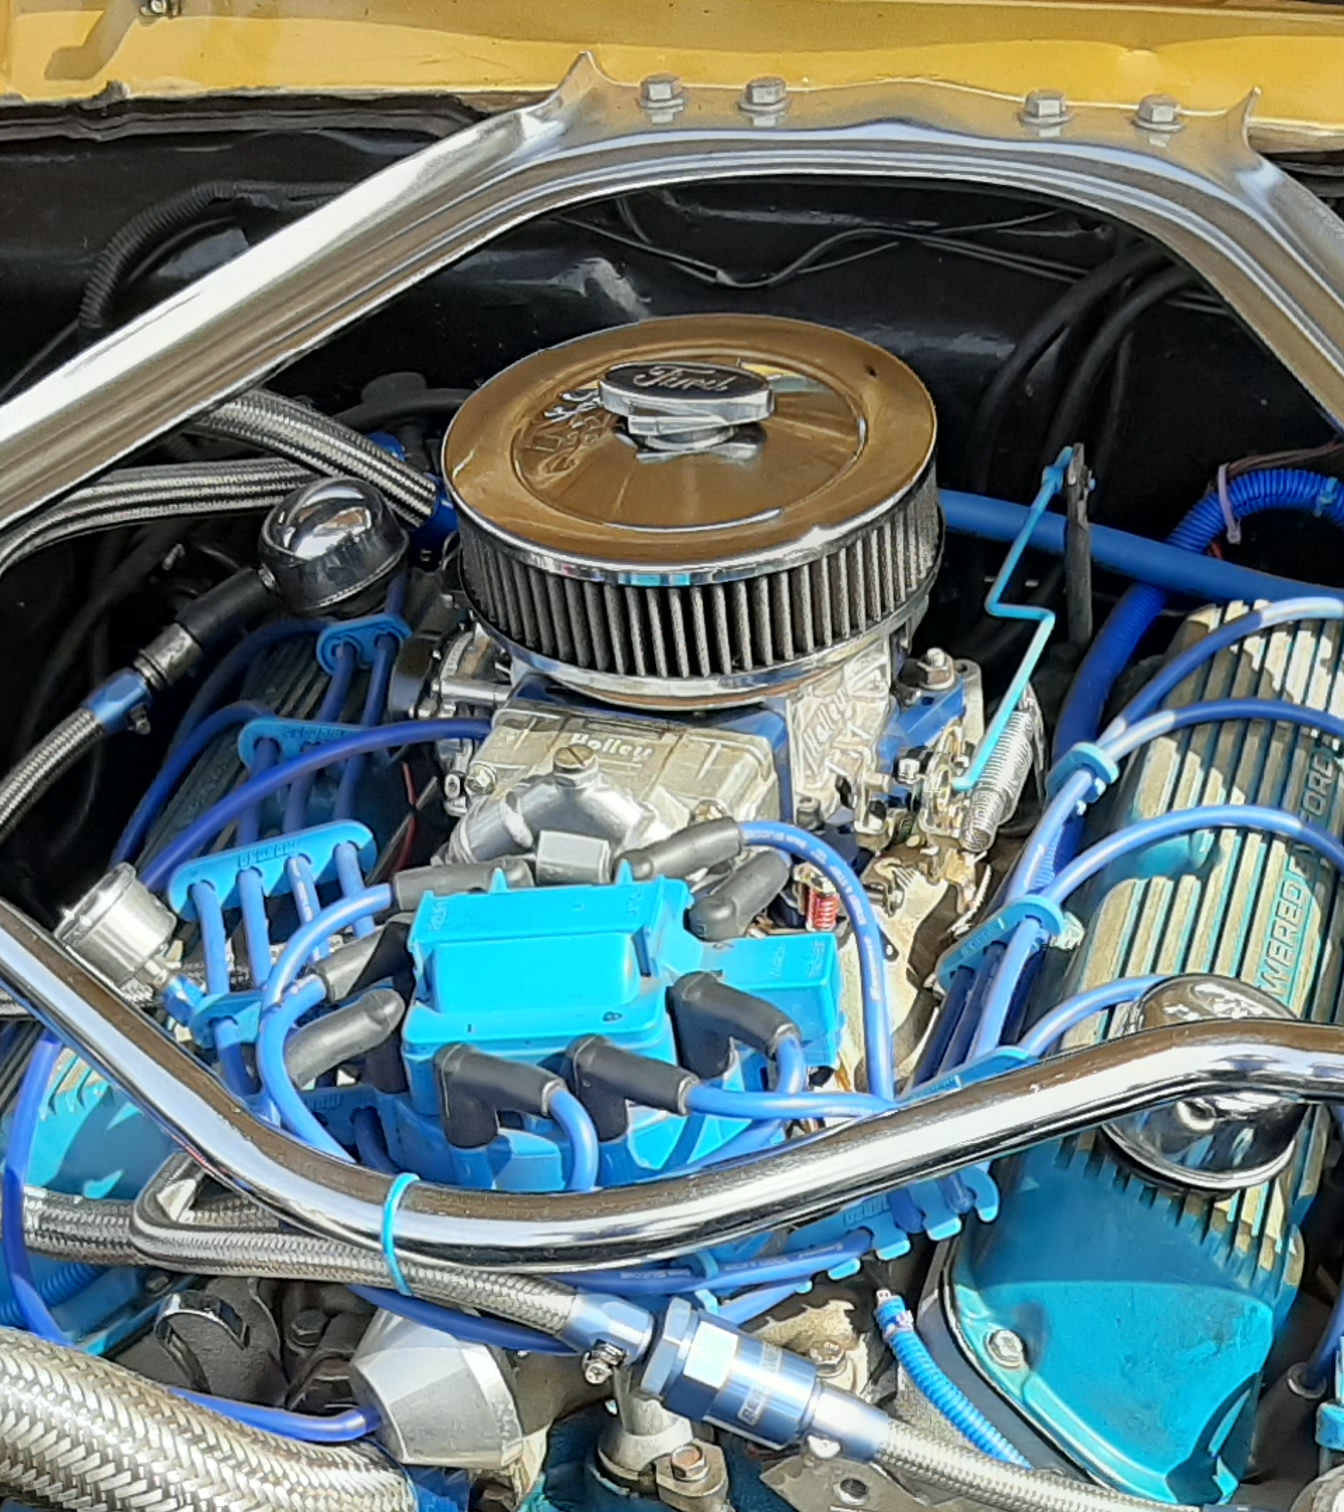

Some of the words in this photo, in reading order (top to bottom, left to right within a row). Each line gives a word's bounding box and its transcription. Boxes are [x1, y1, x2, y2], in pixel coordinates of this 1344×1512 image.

[633, 366, 737, 391] Ford
[802, 690, 849, 751] Holley
[571, 732, 653, 760] Holley
[1258, 880, 1305, 998] WERED
